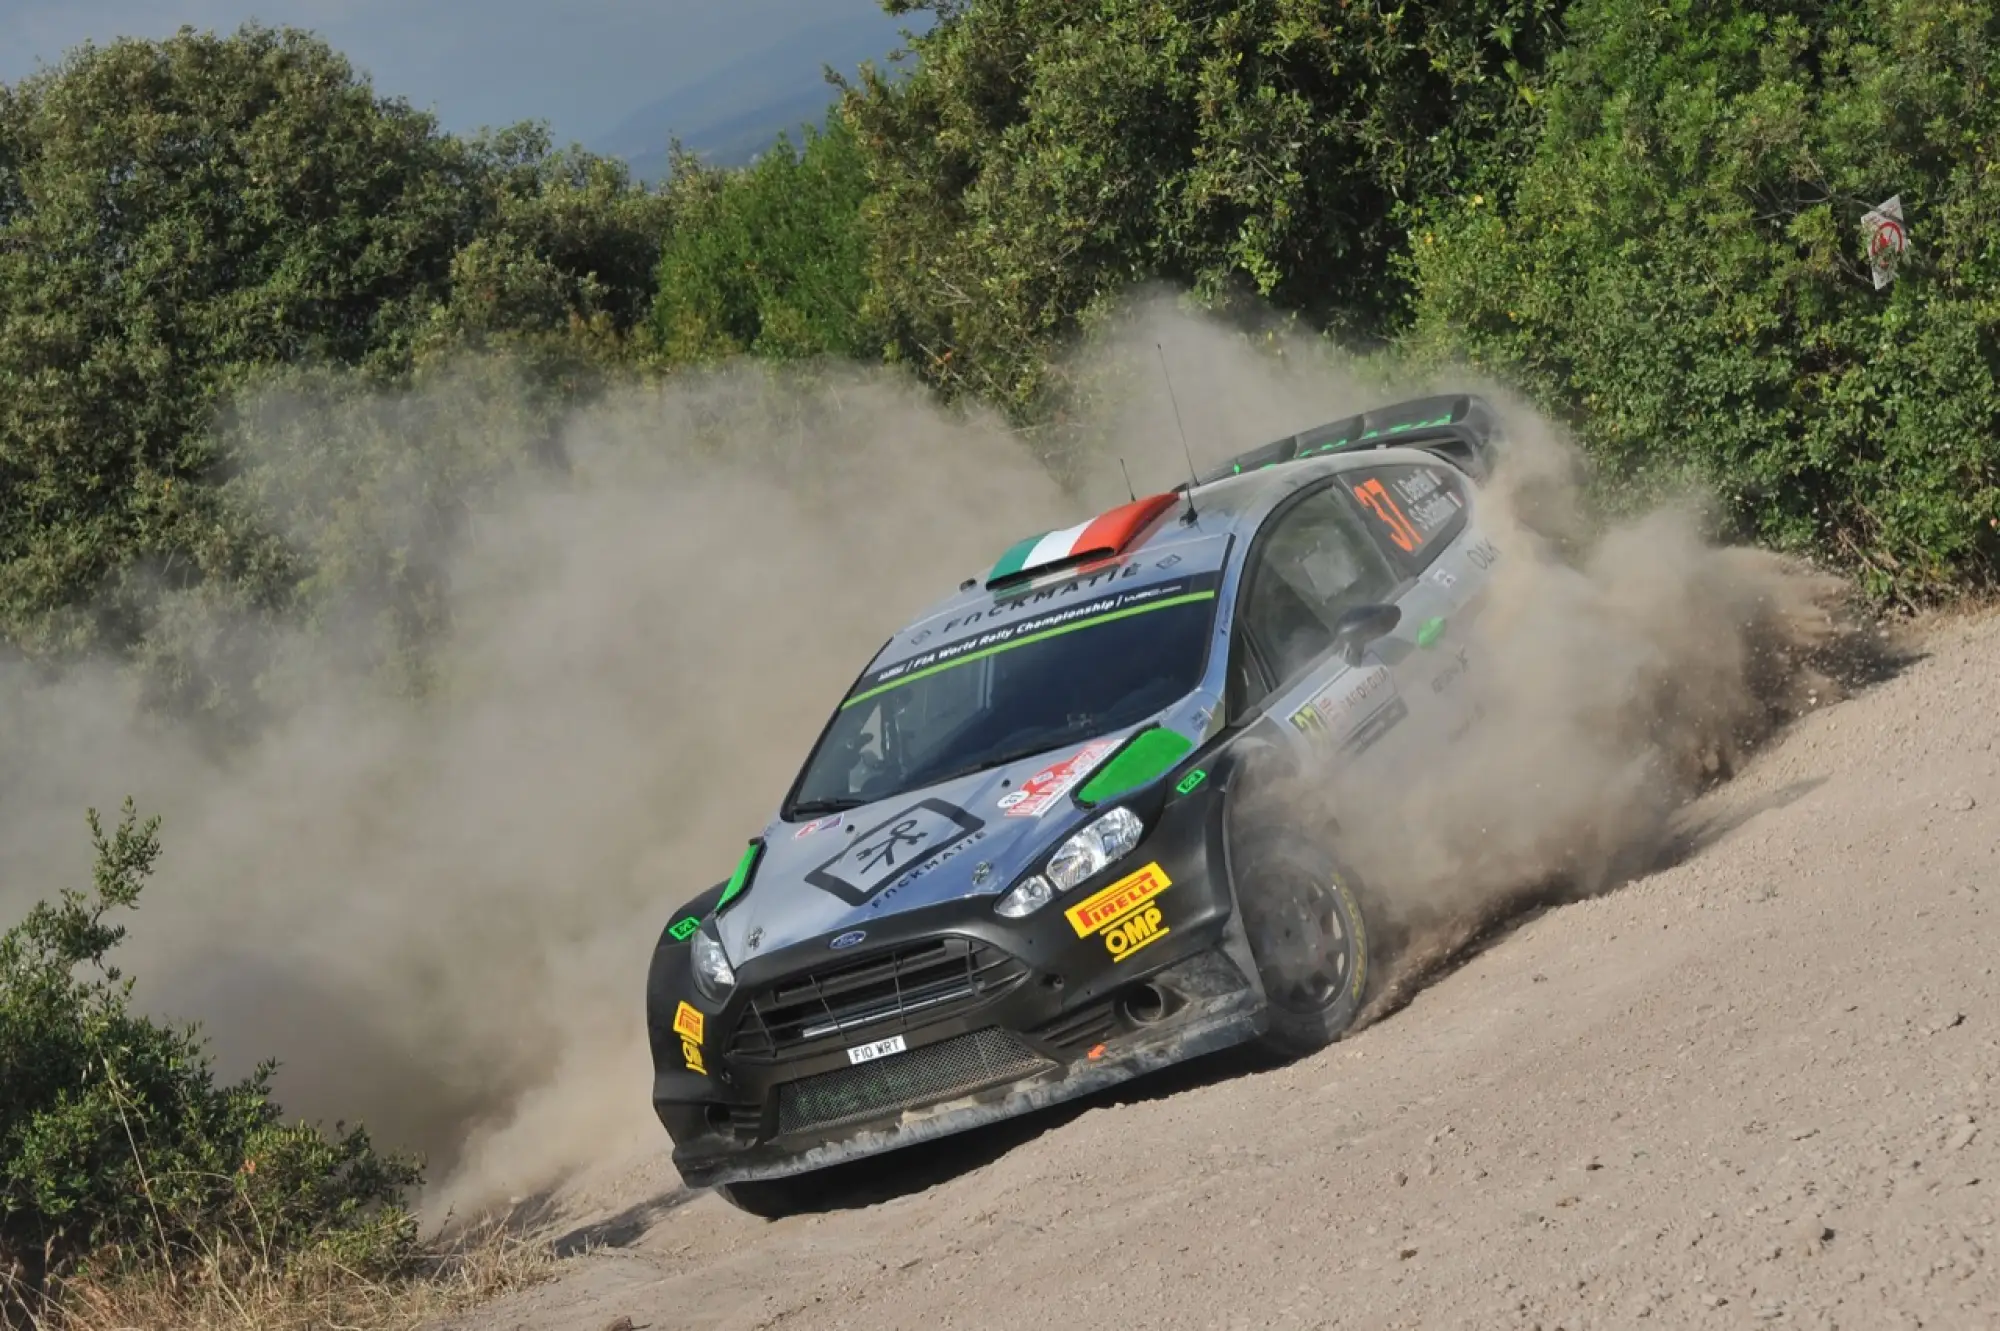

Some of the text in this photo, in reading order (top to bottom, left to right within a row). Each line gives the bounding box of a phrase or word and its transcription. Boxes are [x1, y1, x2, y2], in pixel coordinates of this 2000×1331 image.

[1354, 478, 1422, 551] 37
[939, 639, 976, 659] World
[979, 629, 1014, 646] Rally
[1016, 600, 1114, 634] Championship
[1077, 871, 1158, 928] PIRELLI
[1106, 907, 1162, 953] OMP
[875, 1038, 899, 1055] WRT
